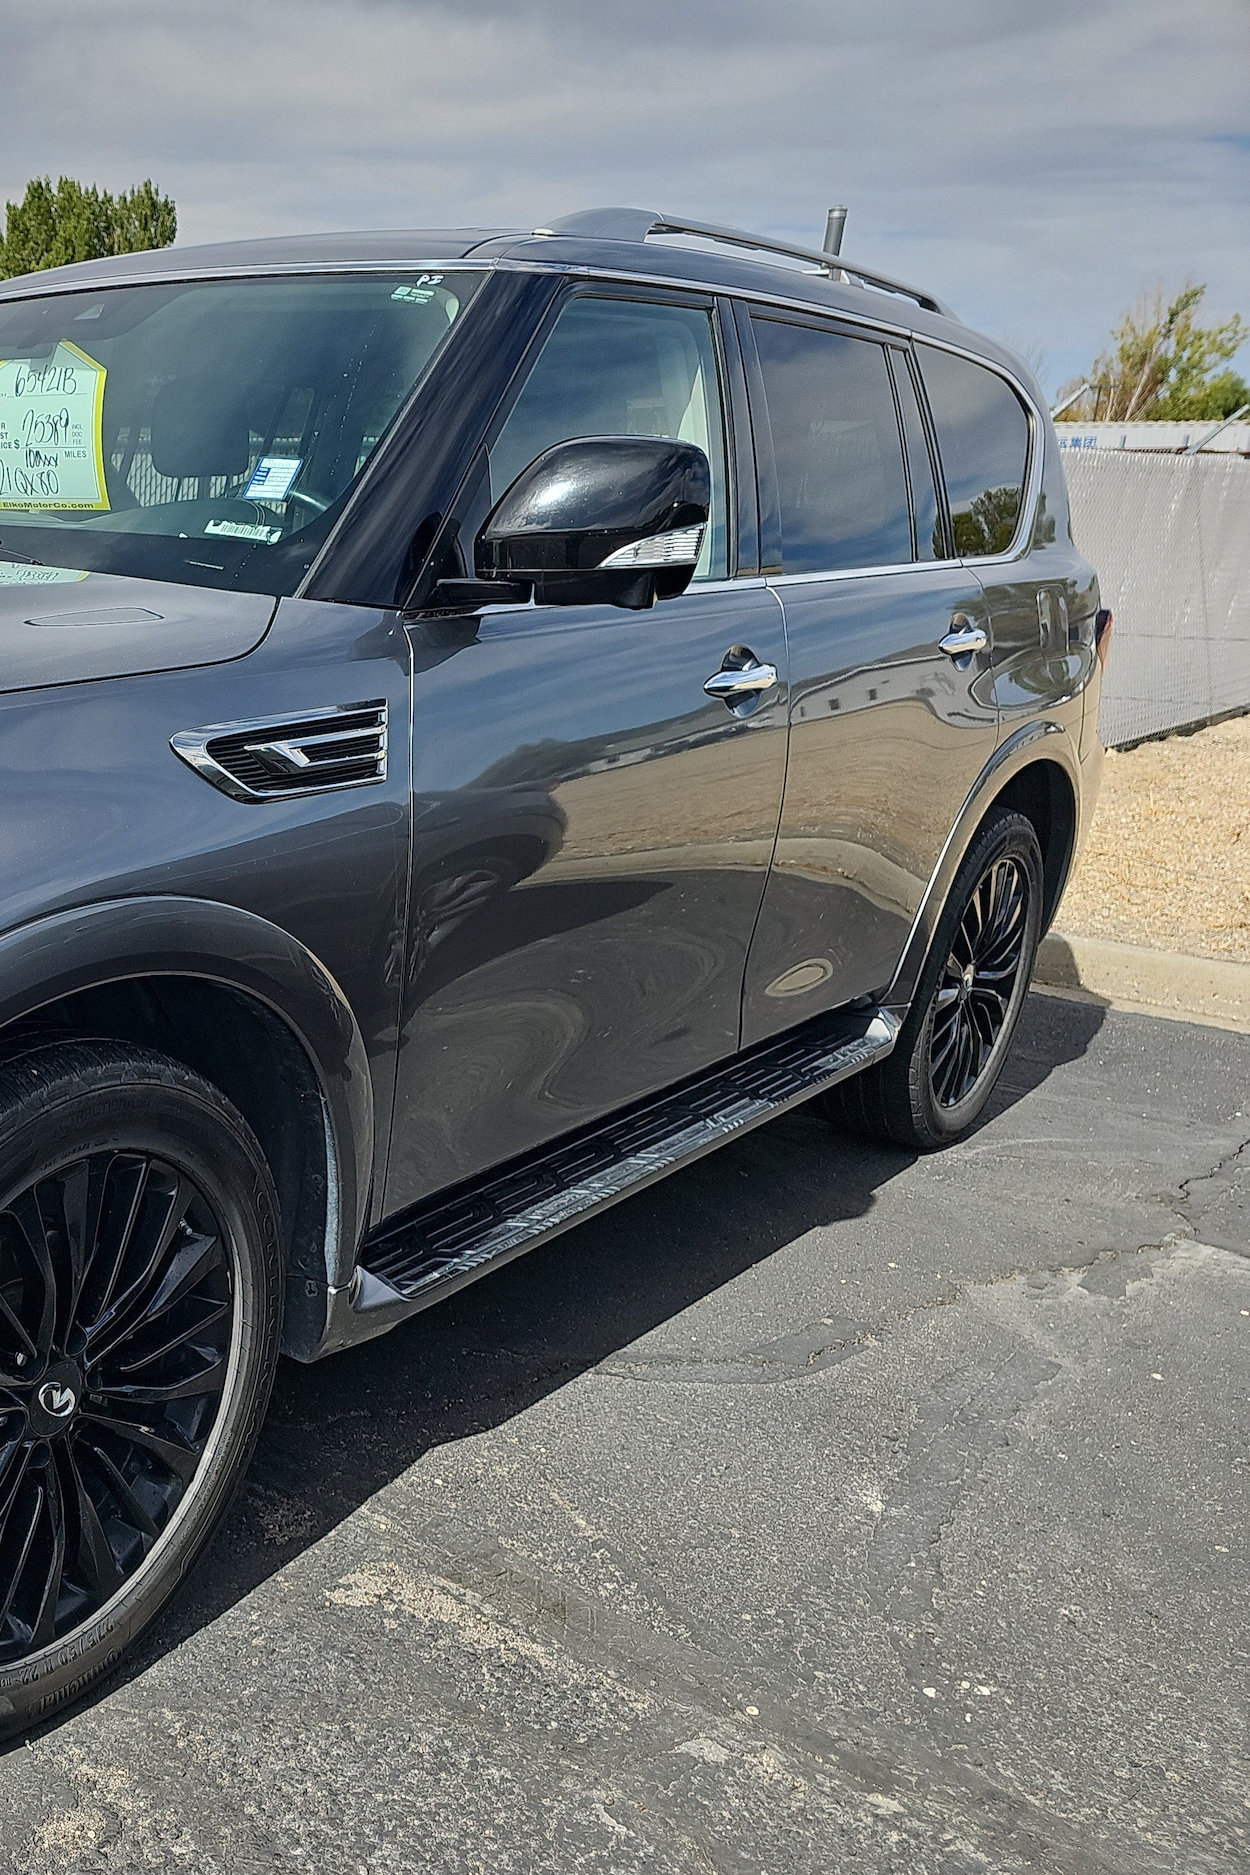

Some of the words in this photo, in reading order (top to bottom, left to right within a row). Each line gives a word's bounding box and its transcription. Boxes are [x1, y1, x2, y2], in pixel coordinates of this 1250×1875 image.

[15, 364, 77, 397] 65421B
[22, 407, 70, 447] 25389
[13, 438, 21, 450] $
[64, 450, 87, 458] MILES
[14, 467, 59, 496] QX80
[2, 501, 94, 509] ElkoMotorCo.com
